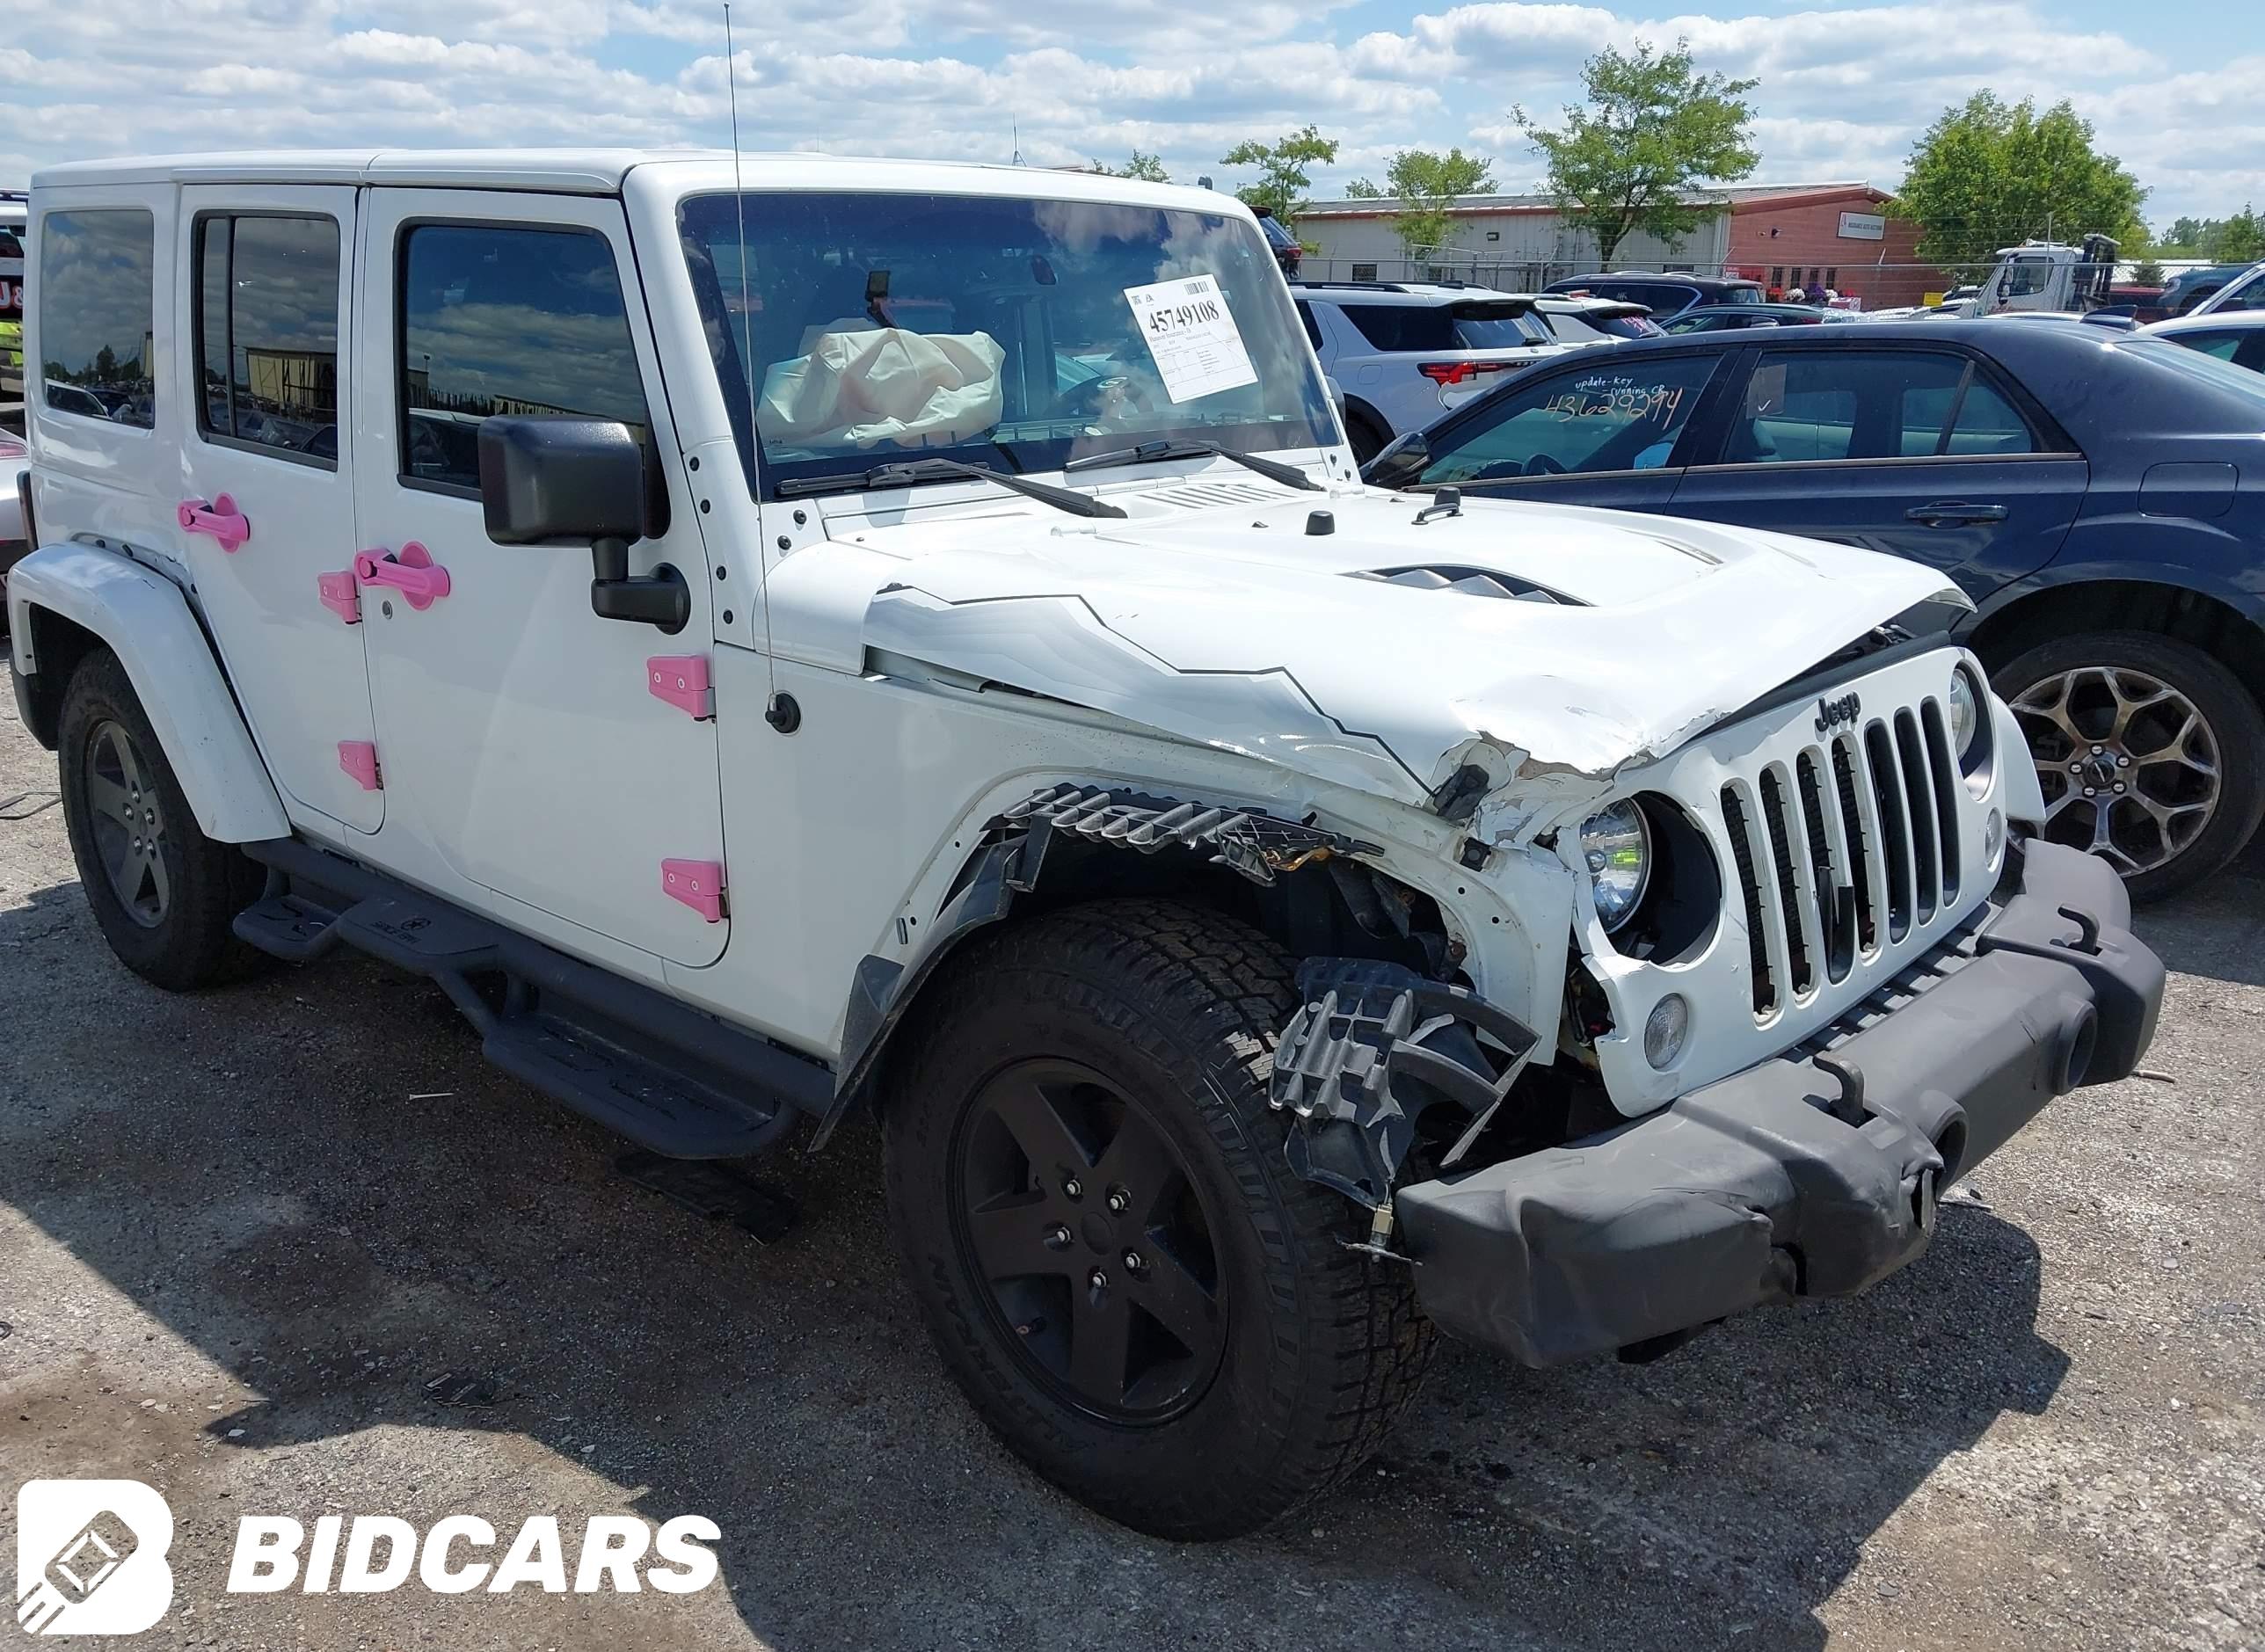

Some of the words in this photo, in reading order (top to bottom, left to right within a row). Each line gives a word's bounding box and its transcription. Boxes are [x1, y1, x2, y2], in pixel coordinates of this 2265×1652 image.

[1149, 300, 1220, 332] 45749108
[1545, 387, 1683, 431] 43629294
[1815, 691, 1861, 732] Jeep
